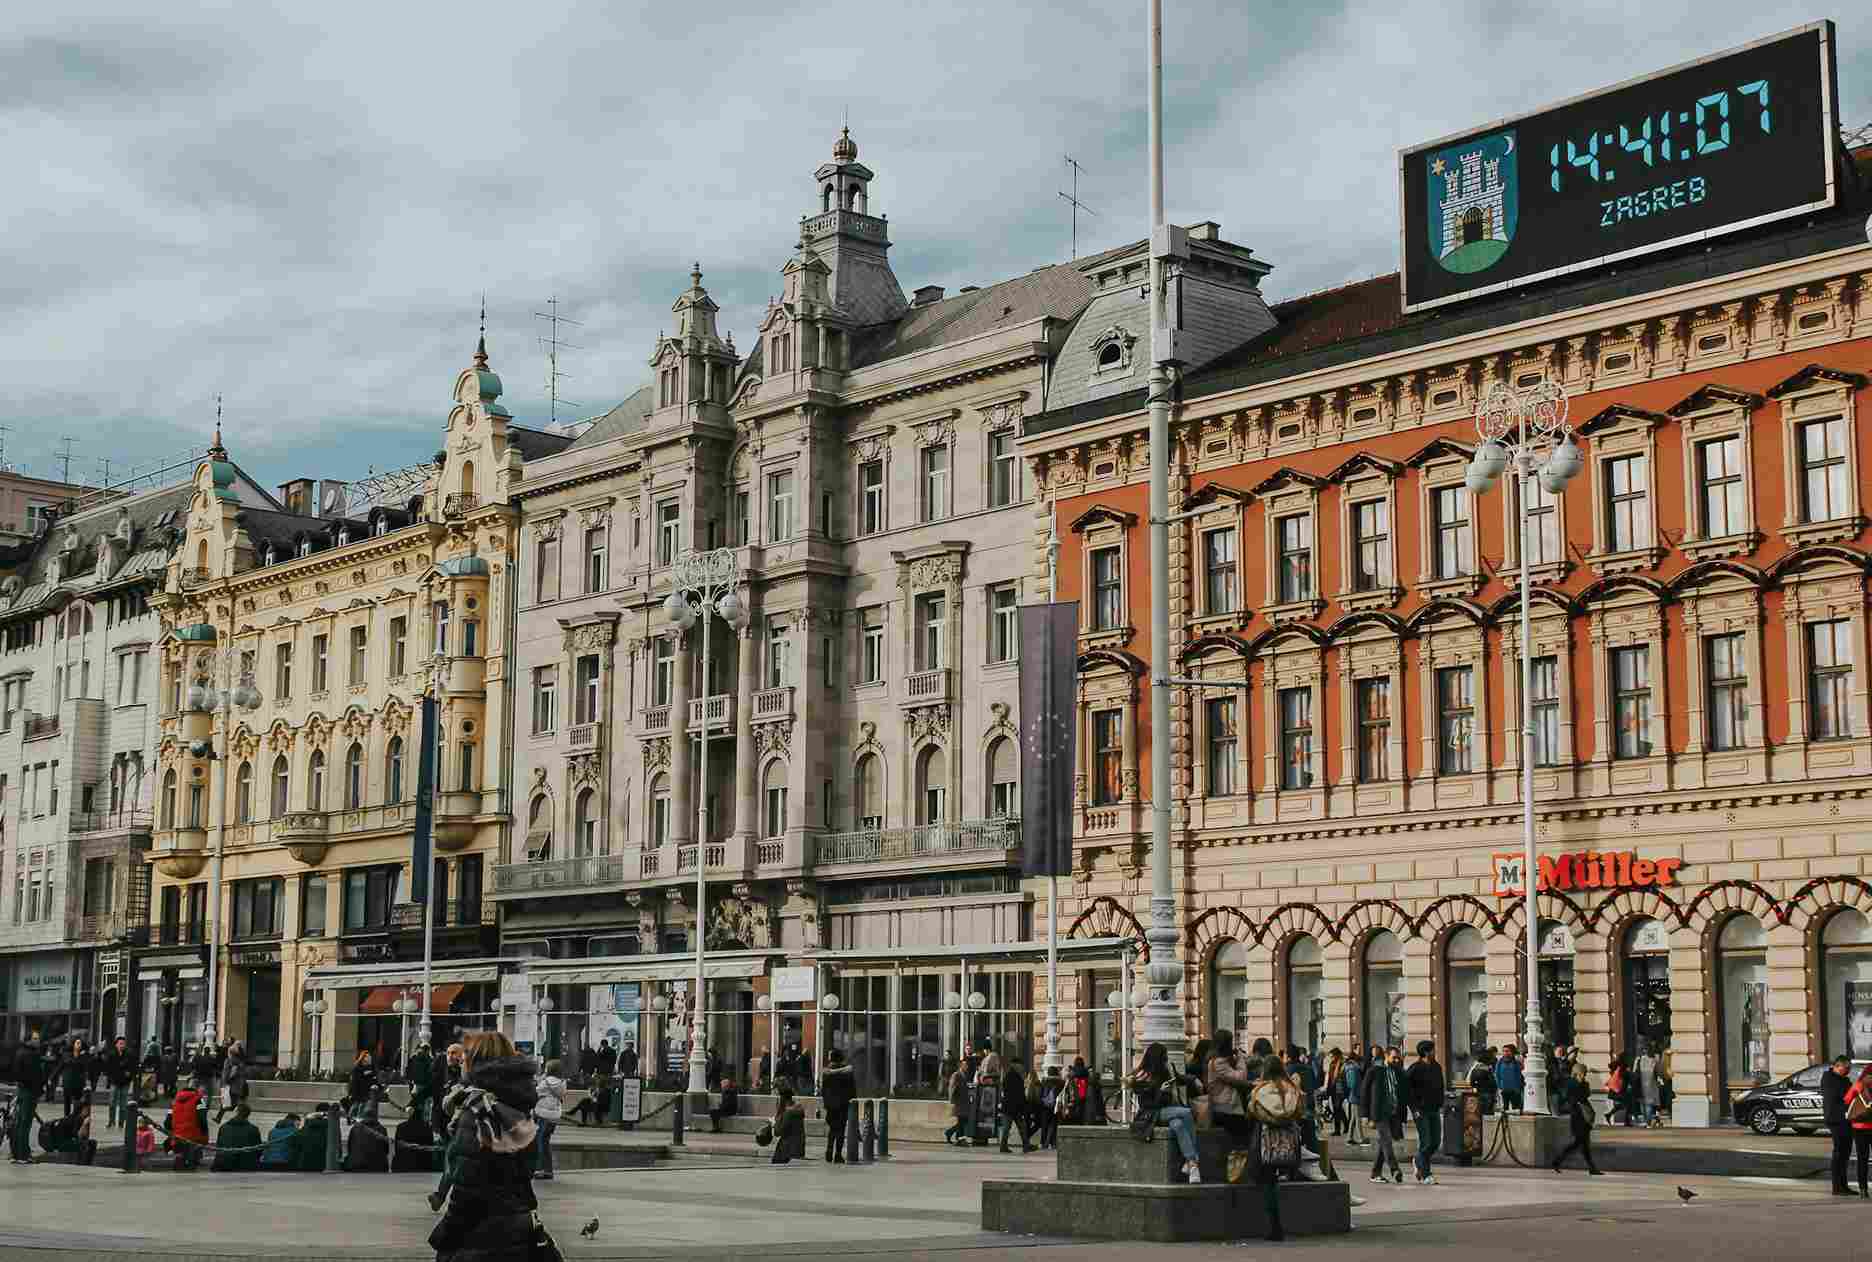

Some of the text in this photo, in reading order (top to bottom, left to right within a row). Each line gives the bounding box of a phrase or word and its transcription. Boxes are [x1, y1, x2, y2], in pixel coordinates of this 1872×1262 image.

[1551, 79, 1770, 192] 14:41:07
[1600, 176, 1705, 227] ZAGREB
[1536, 851, 1680, 890] Müller
